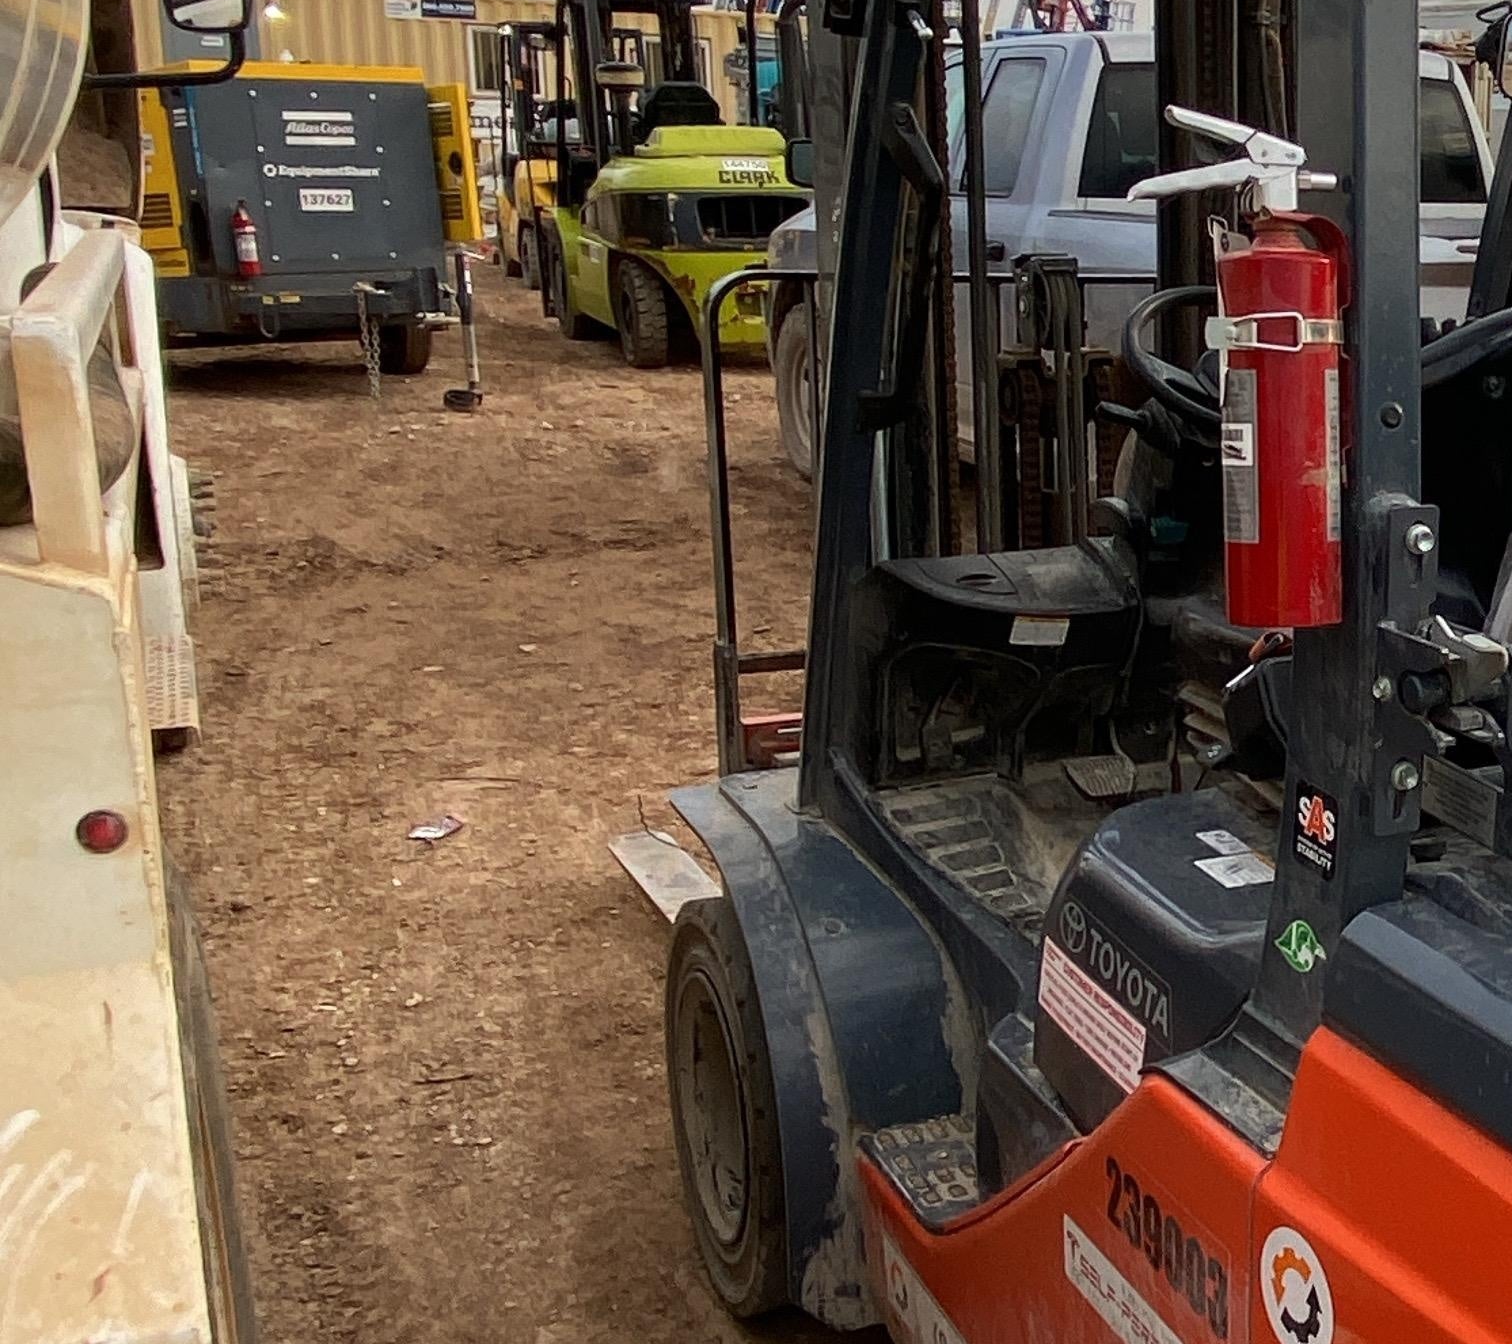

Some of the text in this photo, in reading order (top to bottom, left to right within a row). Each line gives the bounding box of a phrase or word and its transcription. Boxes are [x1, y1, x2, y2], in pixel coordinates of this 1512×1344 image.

[302, 193, 351, 206] 137627
[718, 170, 781, 184] CLARK
[1298, 795, 1336, 846] SAS
[1088, 927, 1169, 1039] TOYOTA
[1105, 1155, 1230, 1341] 239003
